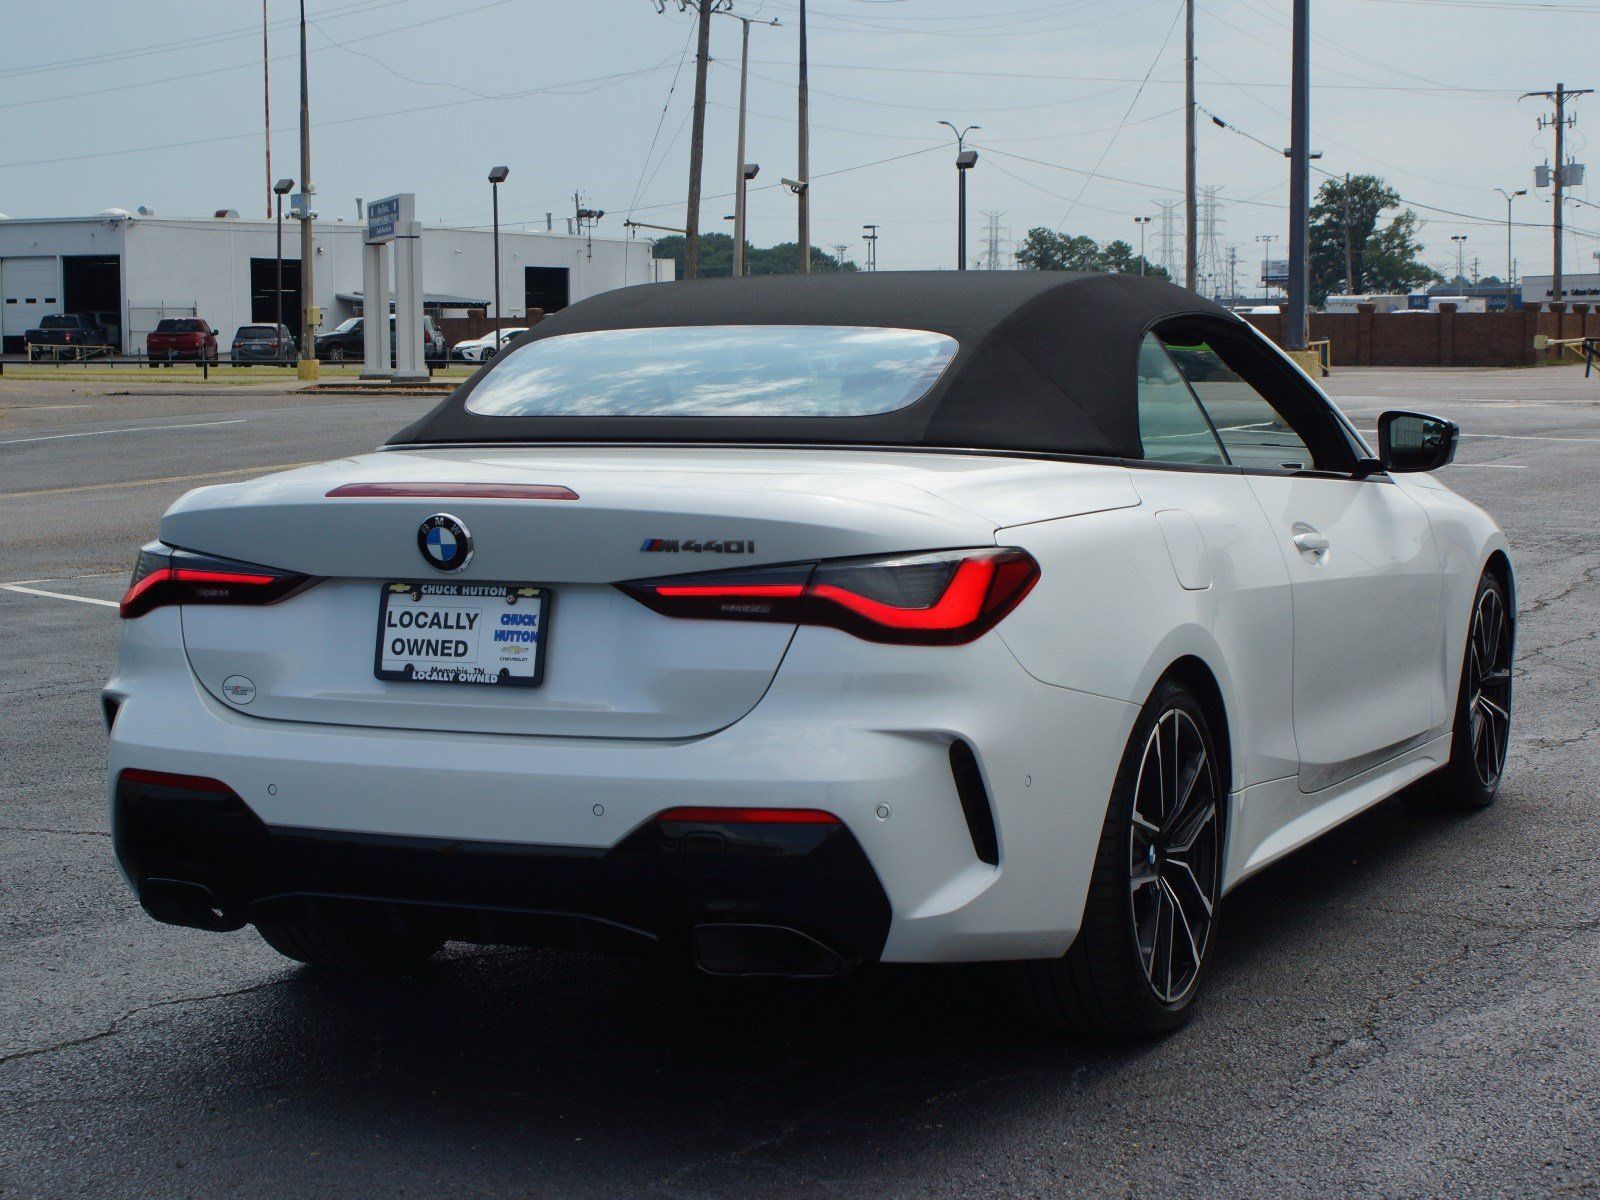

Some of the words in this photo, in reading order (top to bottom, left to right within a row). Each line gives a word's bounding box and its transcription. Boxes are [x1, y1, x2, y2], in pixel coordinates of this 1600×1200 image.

[421, 516, 463, 536] BMW
[421, 584, 458, 595] CHUCK
[461, 586, 507, 597] HUTTON
[387, 610, 480, 631] LOCALLY
[501, 613, 538, 627] CHUCK
[493, 629, 538, 643] HUTTON
[391, 637, 469, 658] OWNED
[412, 670, 455, 682] LOCALLY
[458, 673, 498, 684] OWNED
